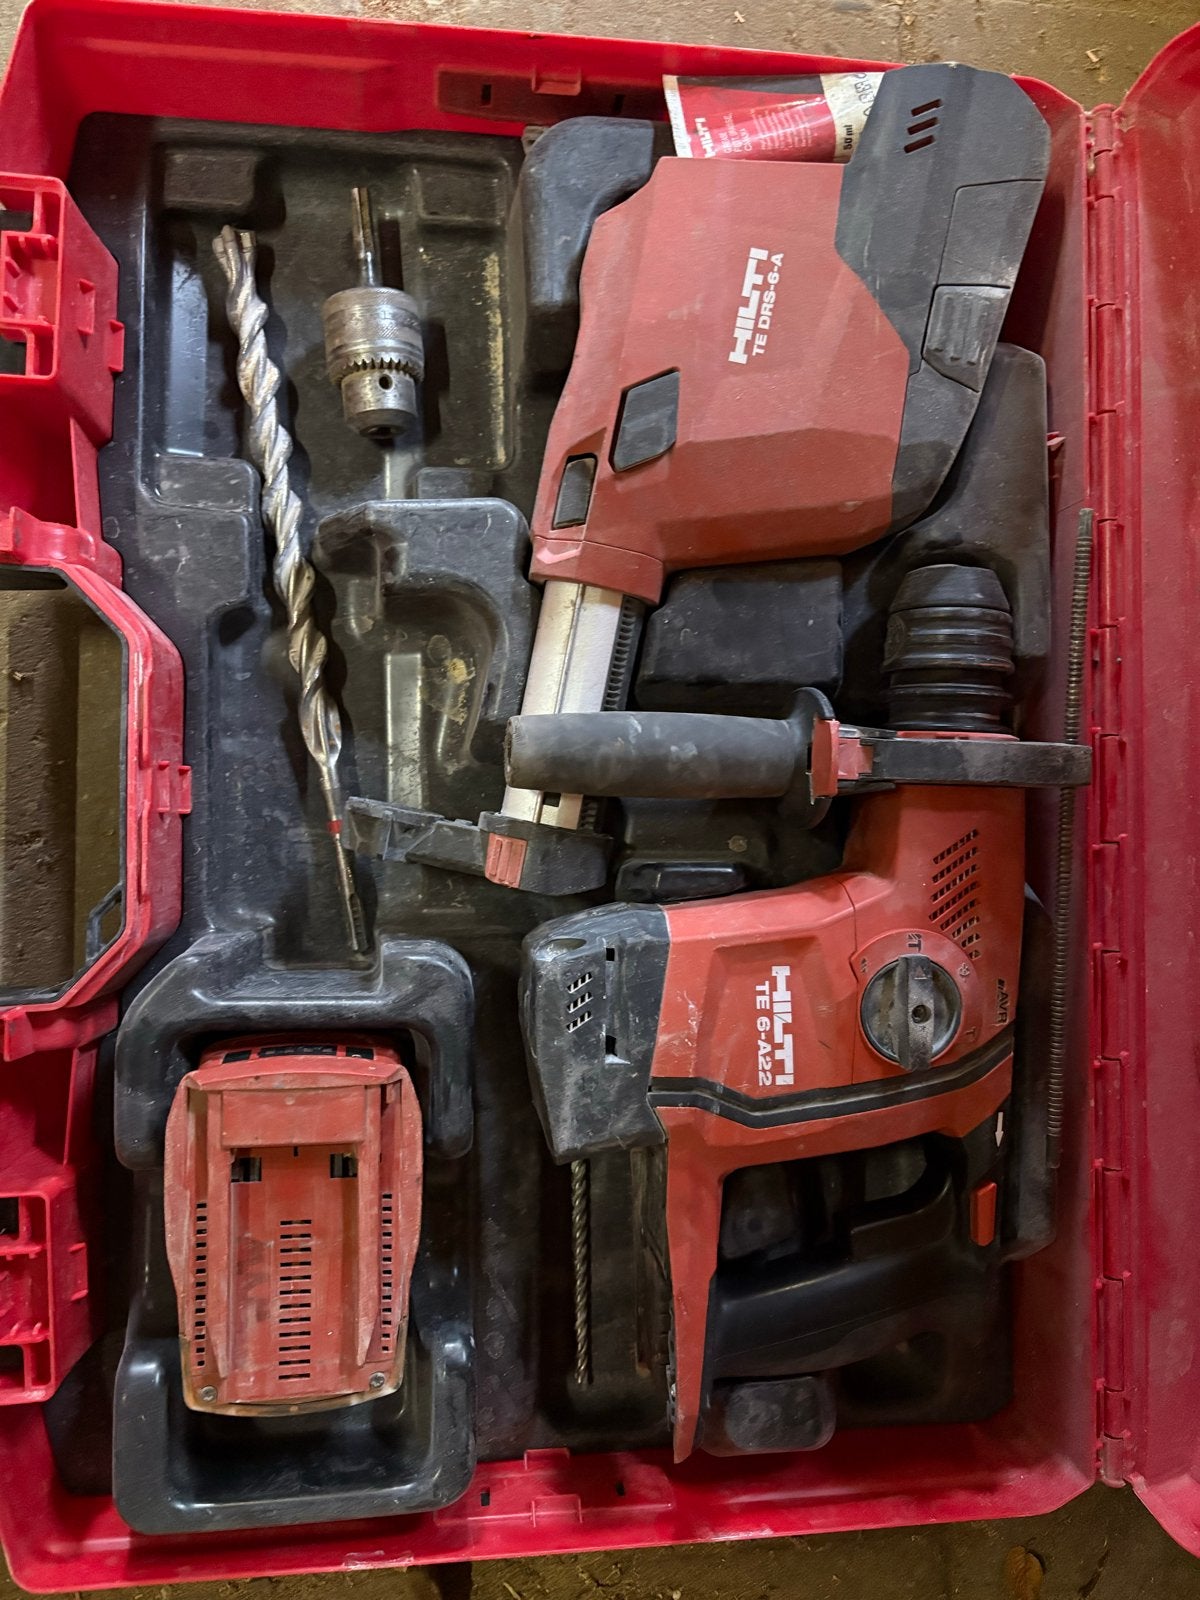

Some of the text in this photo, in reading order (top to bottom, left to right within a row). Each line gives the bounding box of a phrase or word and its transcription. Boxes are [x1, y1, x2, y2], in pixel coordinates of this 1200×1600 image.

[694, 117, 716, 158] HILTI
[728, 247, 769, 364] HILTI
[752, 253, 785, 357] TE DRS-6-A
[755, 980, 772, 1087] TE 6-A22
[771, 965, 794, 1086] HILTI
[998, 991, 1009, 1023] AVR
